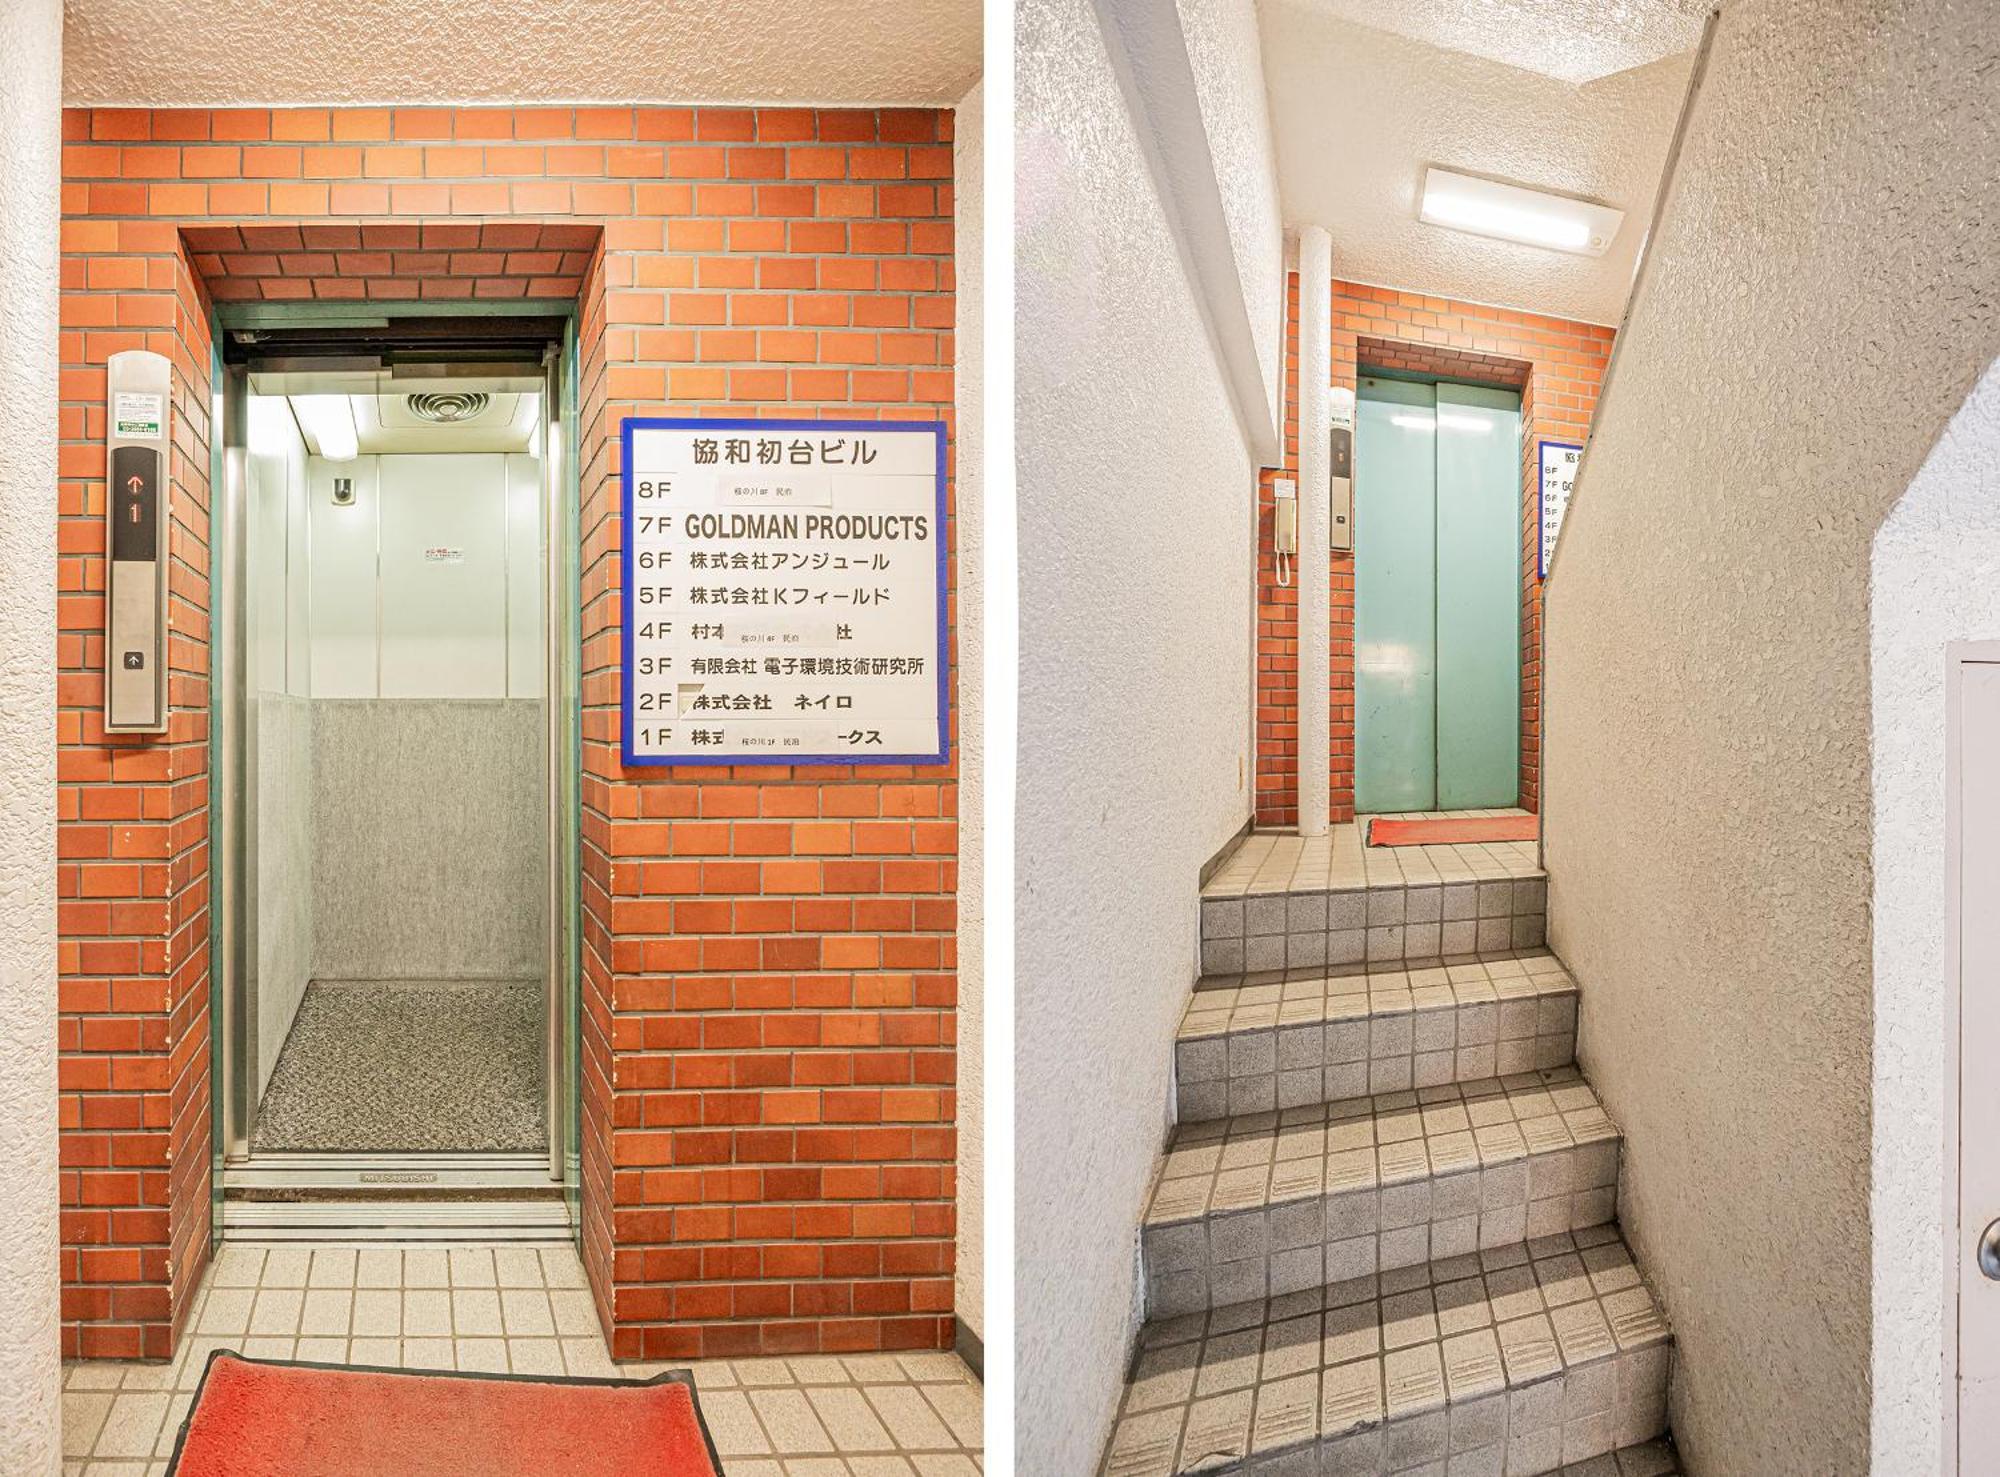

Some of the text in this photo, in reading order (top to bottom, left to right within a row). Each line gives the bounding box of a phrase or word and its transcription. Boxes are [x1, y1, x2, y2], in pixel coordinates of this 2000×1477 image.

[693, 438, 878, 465] 協和初台ビル
[638, 482, 672, 498] 8F
[639, 513, 928, 541] 7F GOLDMAN PRODUCTS
[639, 551, 891, 571] 6F 株式会社アンジュール
[639, 586, 891, 606] 5F 株式会社Kフィールド
[639, 622, 673, 640] 4F
[639, 657, 925, 676] 3F 有限会社 電子環境技術研究所
[639, 693, 673, 711] 2F
[793, 693, 853, 711] ネイロ
[640, 728, 673, 746] 1F
